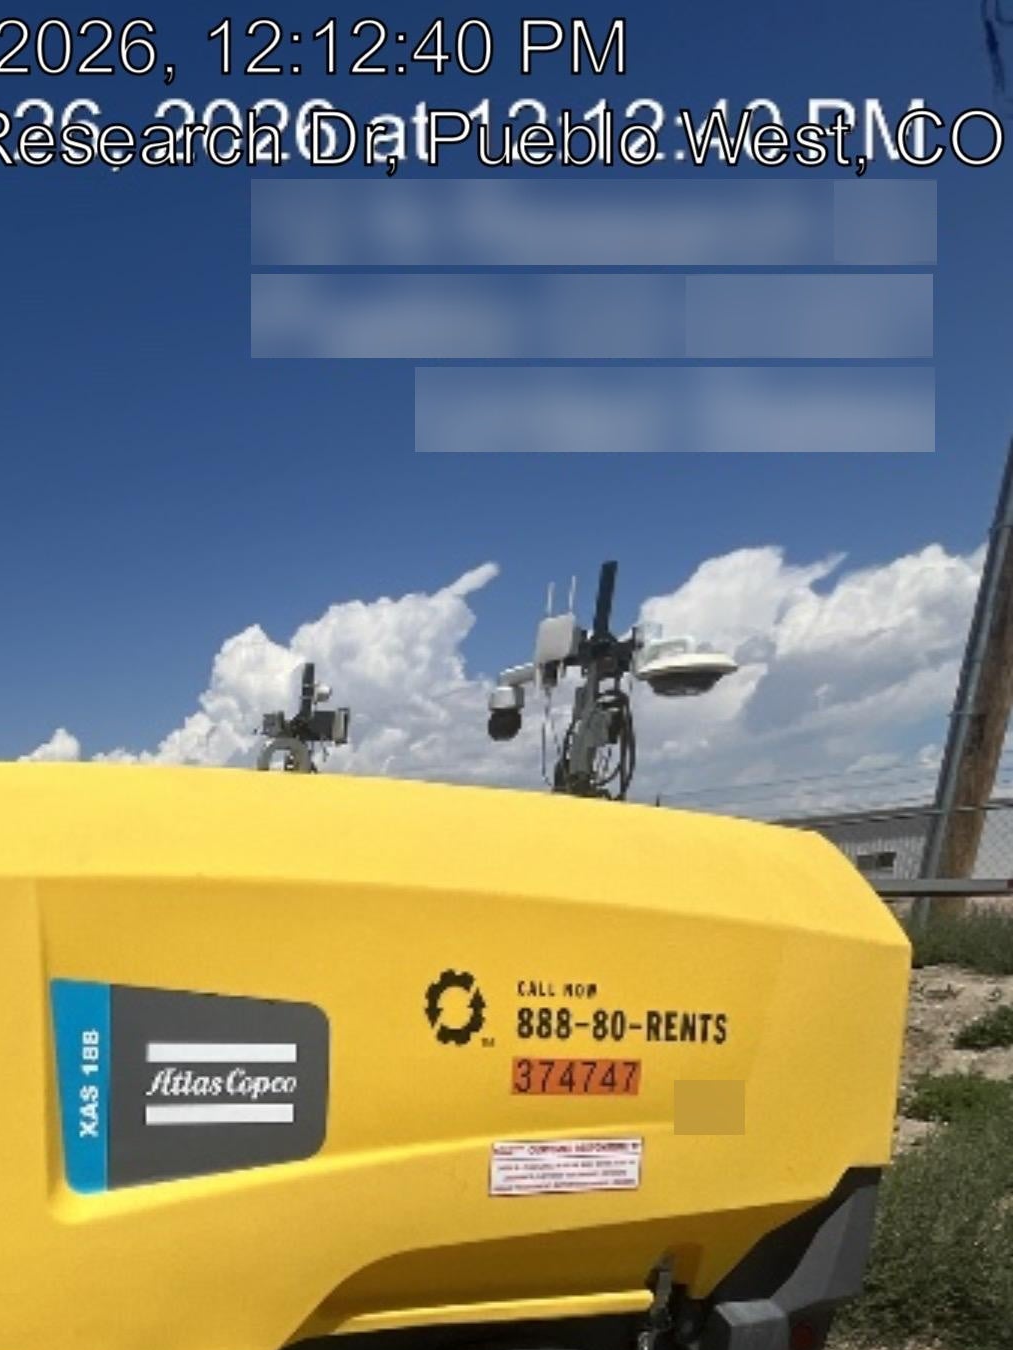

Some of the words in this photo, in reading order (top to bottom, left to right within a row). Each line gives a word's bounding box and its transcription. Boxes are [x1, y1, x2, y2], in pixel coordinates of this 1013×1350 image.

[517, 980, 556, 998] CALL
[563, 983, 598, 999] NOW
[516, 1006, 729, 1045] 888-80-RENTS
[145, 1066, 225, 1096] Atlas
[225, 1066, 298, 1101] Copco
[514, 1058, 640, 1094] 374747
[79, 1085, 100, 1138] XAS
